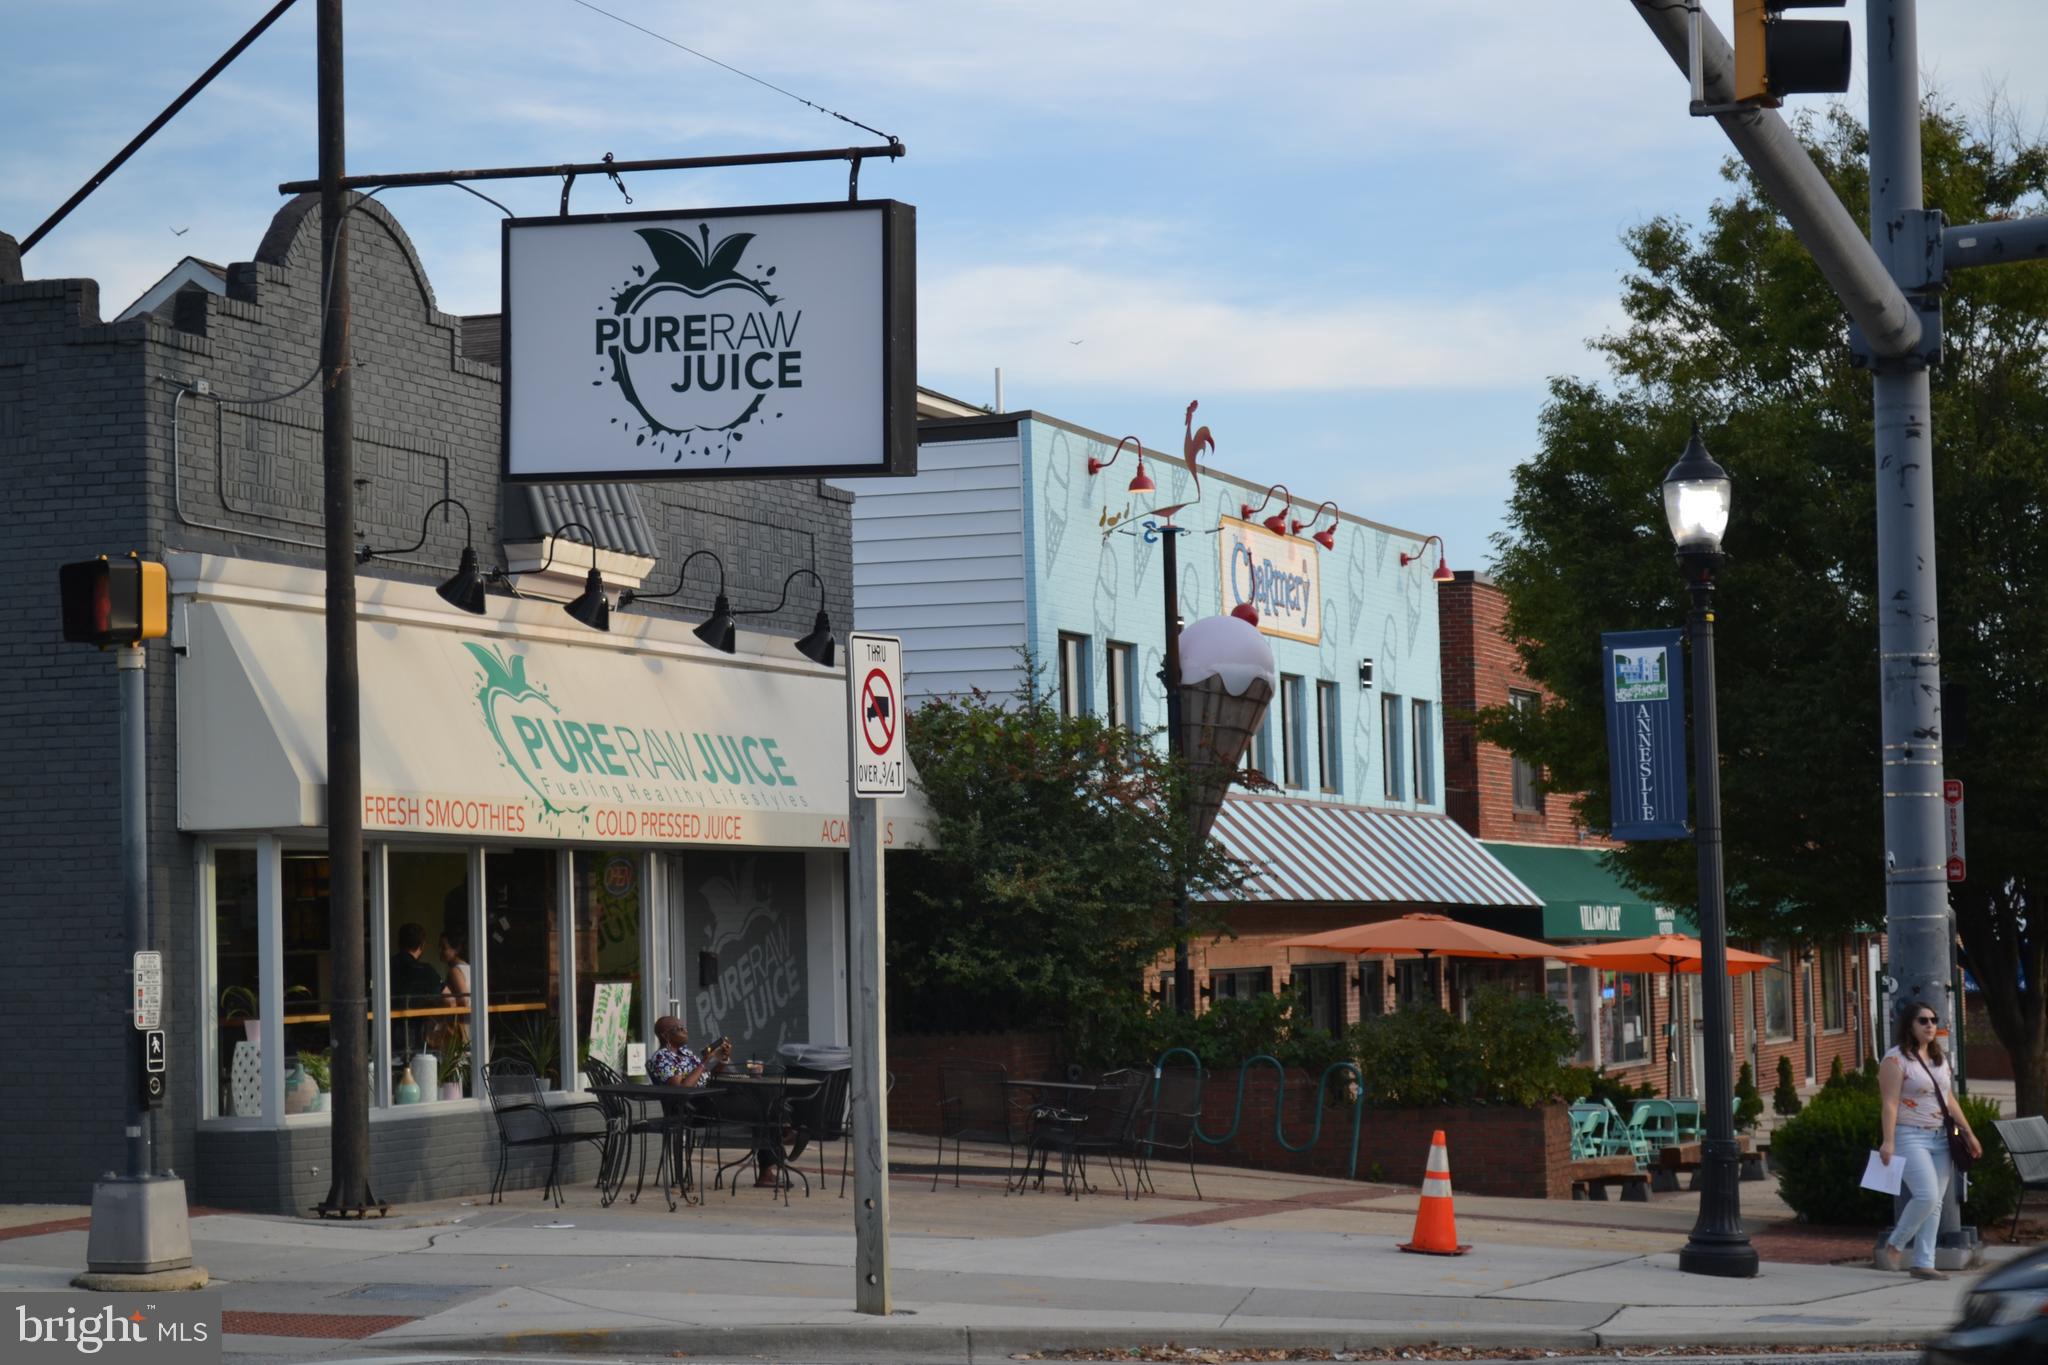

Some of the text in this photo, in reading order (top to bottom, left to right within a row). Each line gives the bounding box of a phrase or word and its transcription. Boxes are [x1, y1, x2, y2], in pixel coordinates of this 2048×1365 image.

[671, 351, 802, 393] JUICE
[866, 644, 886, 662] THRU
[692, 732, 798, 788] JUICE
[859, 764, 877, 783] OVER
[1636, 703, 1655, 822] ANNESLIE
[541, 776, 809, 811] Fueling Healthy Lifestyles
[364, 795, 526, 833] FRESH SMOOTHIES
[595, 809, 742, 841] COLD PRESSED JUICE
[743, 954, 801, 1040] JUICE
